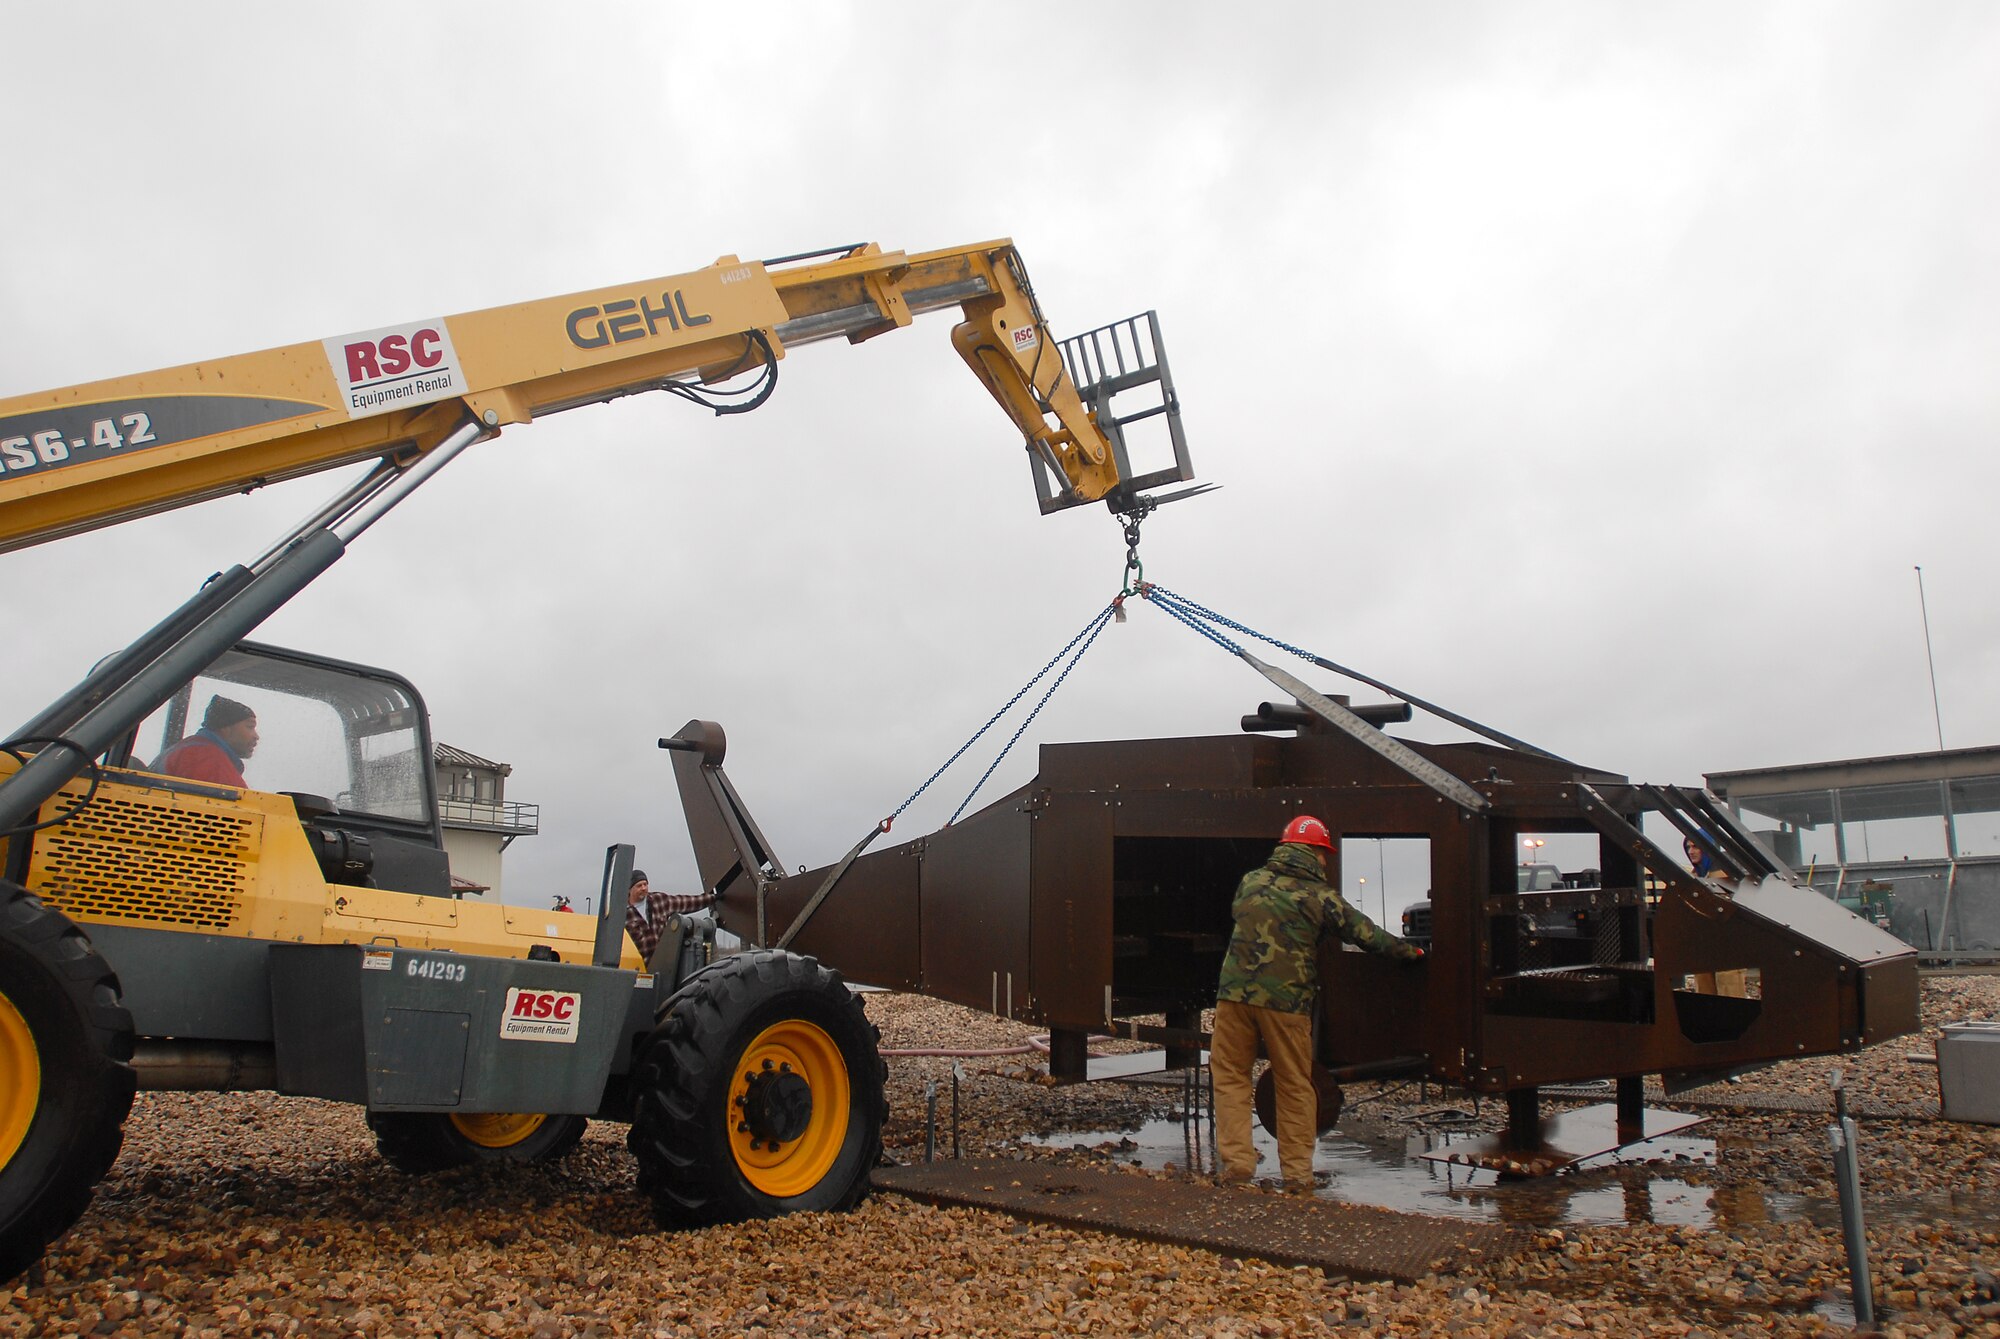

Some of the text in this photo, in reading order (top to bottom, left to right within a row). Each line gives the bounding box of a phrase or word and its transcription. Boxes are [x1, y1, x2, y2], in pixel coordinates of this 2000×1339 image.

[565, 289, 712, 350] GEHL
[1014, 327, 1033, 342] RSC
[344, 328, 443, 383] RSC
[351, 374, 452, 409] Equipment Rental
[0, 411, 158, 474] S6-42
[407, 959, 466, 982] 641293
[512, 992, 575, 1020] RSC
[506, 1022, 570, 1036] Equipment Rental
